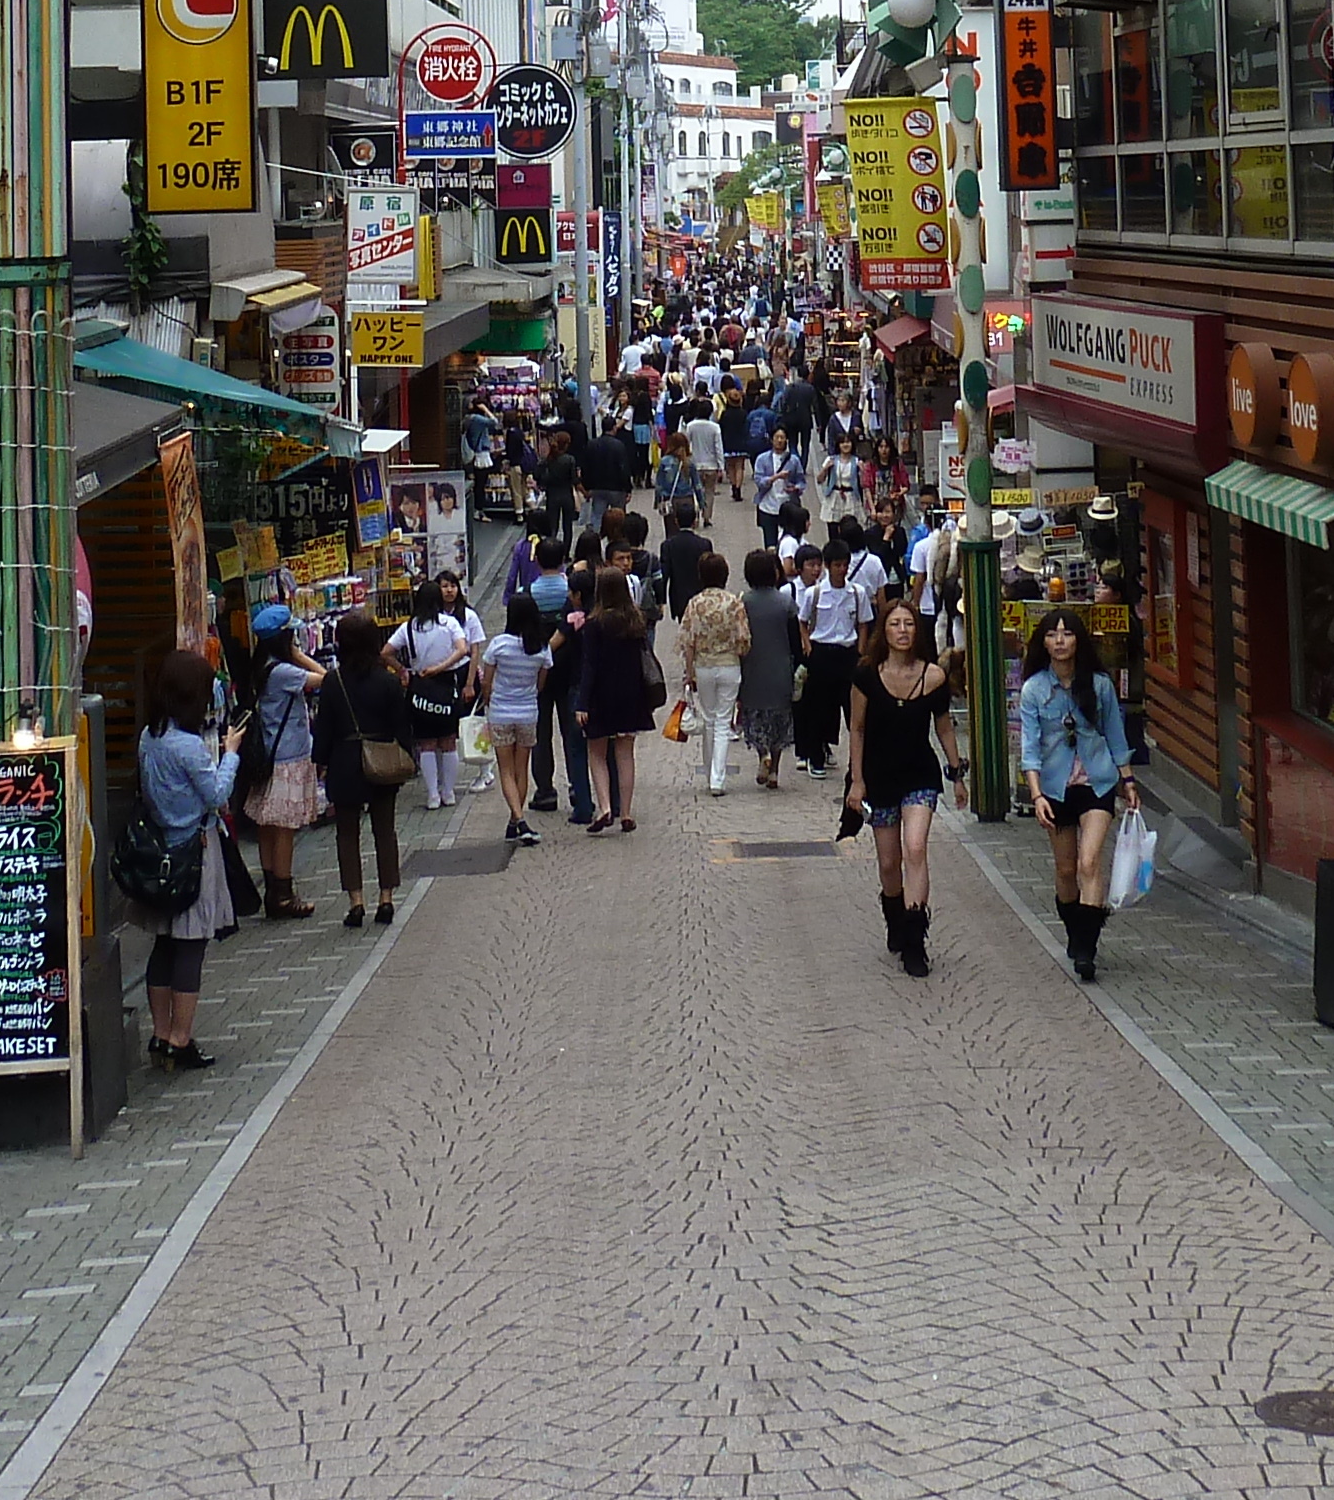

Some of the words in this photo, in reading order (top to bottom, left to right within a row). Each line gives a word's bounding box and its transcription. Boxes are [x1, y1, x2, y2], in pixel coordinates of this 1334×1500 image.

[424, 56, 478, 82] 消火栓
[166, 80, 225, 105] B1F
[499, 83, 541, 101] コミック
[545, 82, 555, 99] &
[422, 118, 478, 134] 東郷神社
[850, 115, 885, 127] NO!!
[188, 121, 225, 147] 2F
[421, 134, 482, 150] 東郷記念館
[513, 130, 546, 148] 2F
[854, 151, 889, 164] NO!!
[157, 159, 242, 191] 190席
[406, 178, 435, 189] PHA
[360, 196, 401, 210] 原宿
[858, 189, 893, 202] NO!!
[352, 213, 411, 242] アイドル
[862, 228, 898, 241] NO!!
[349, 232, 414, 270] 写真センター
[355, 317, 421, 333] ハッピー
[372, 336, 405, 352] ワン
[1046, 314, 1127, 365] WOLFGANG
[1129, 328, 1173, 374] PUCK
[360, 354, 393, 364] HAPPY
[395, 354, 414, 364] ONE
[1130, 376, 1174, 406] EXPRESS
[1231, 378, 1254, 415] live
[1289, 390, 1318, 432] love
[411, 695, 452, 716] kitson
[26, 1036, 58, 1054] SET
